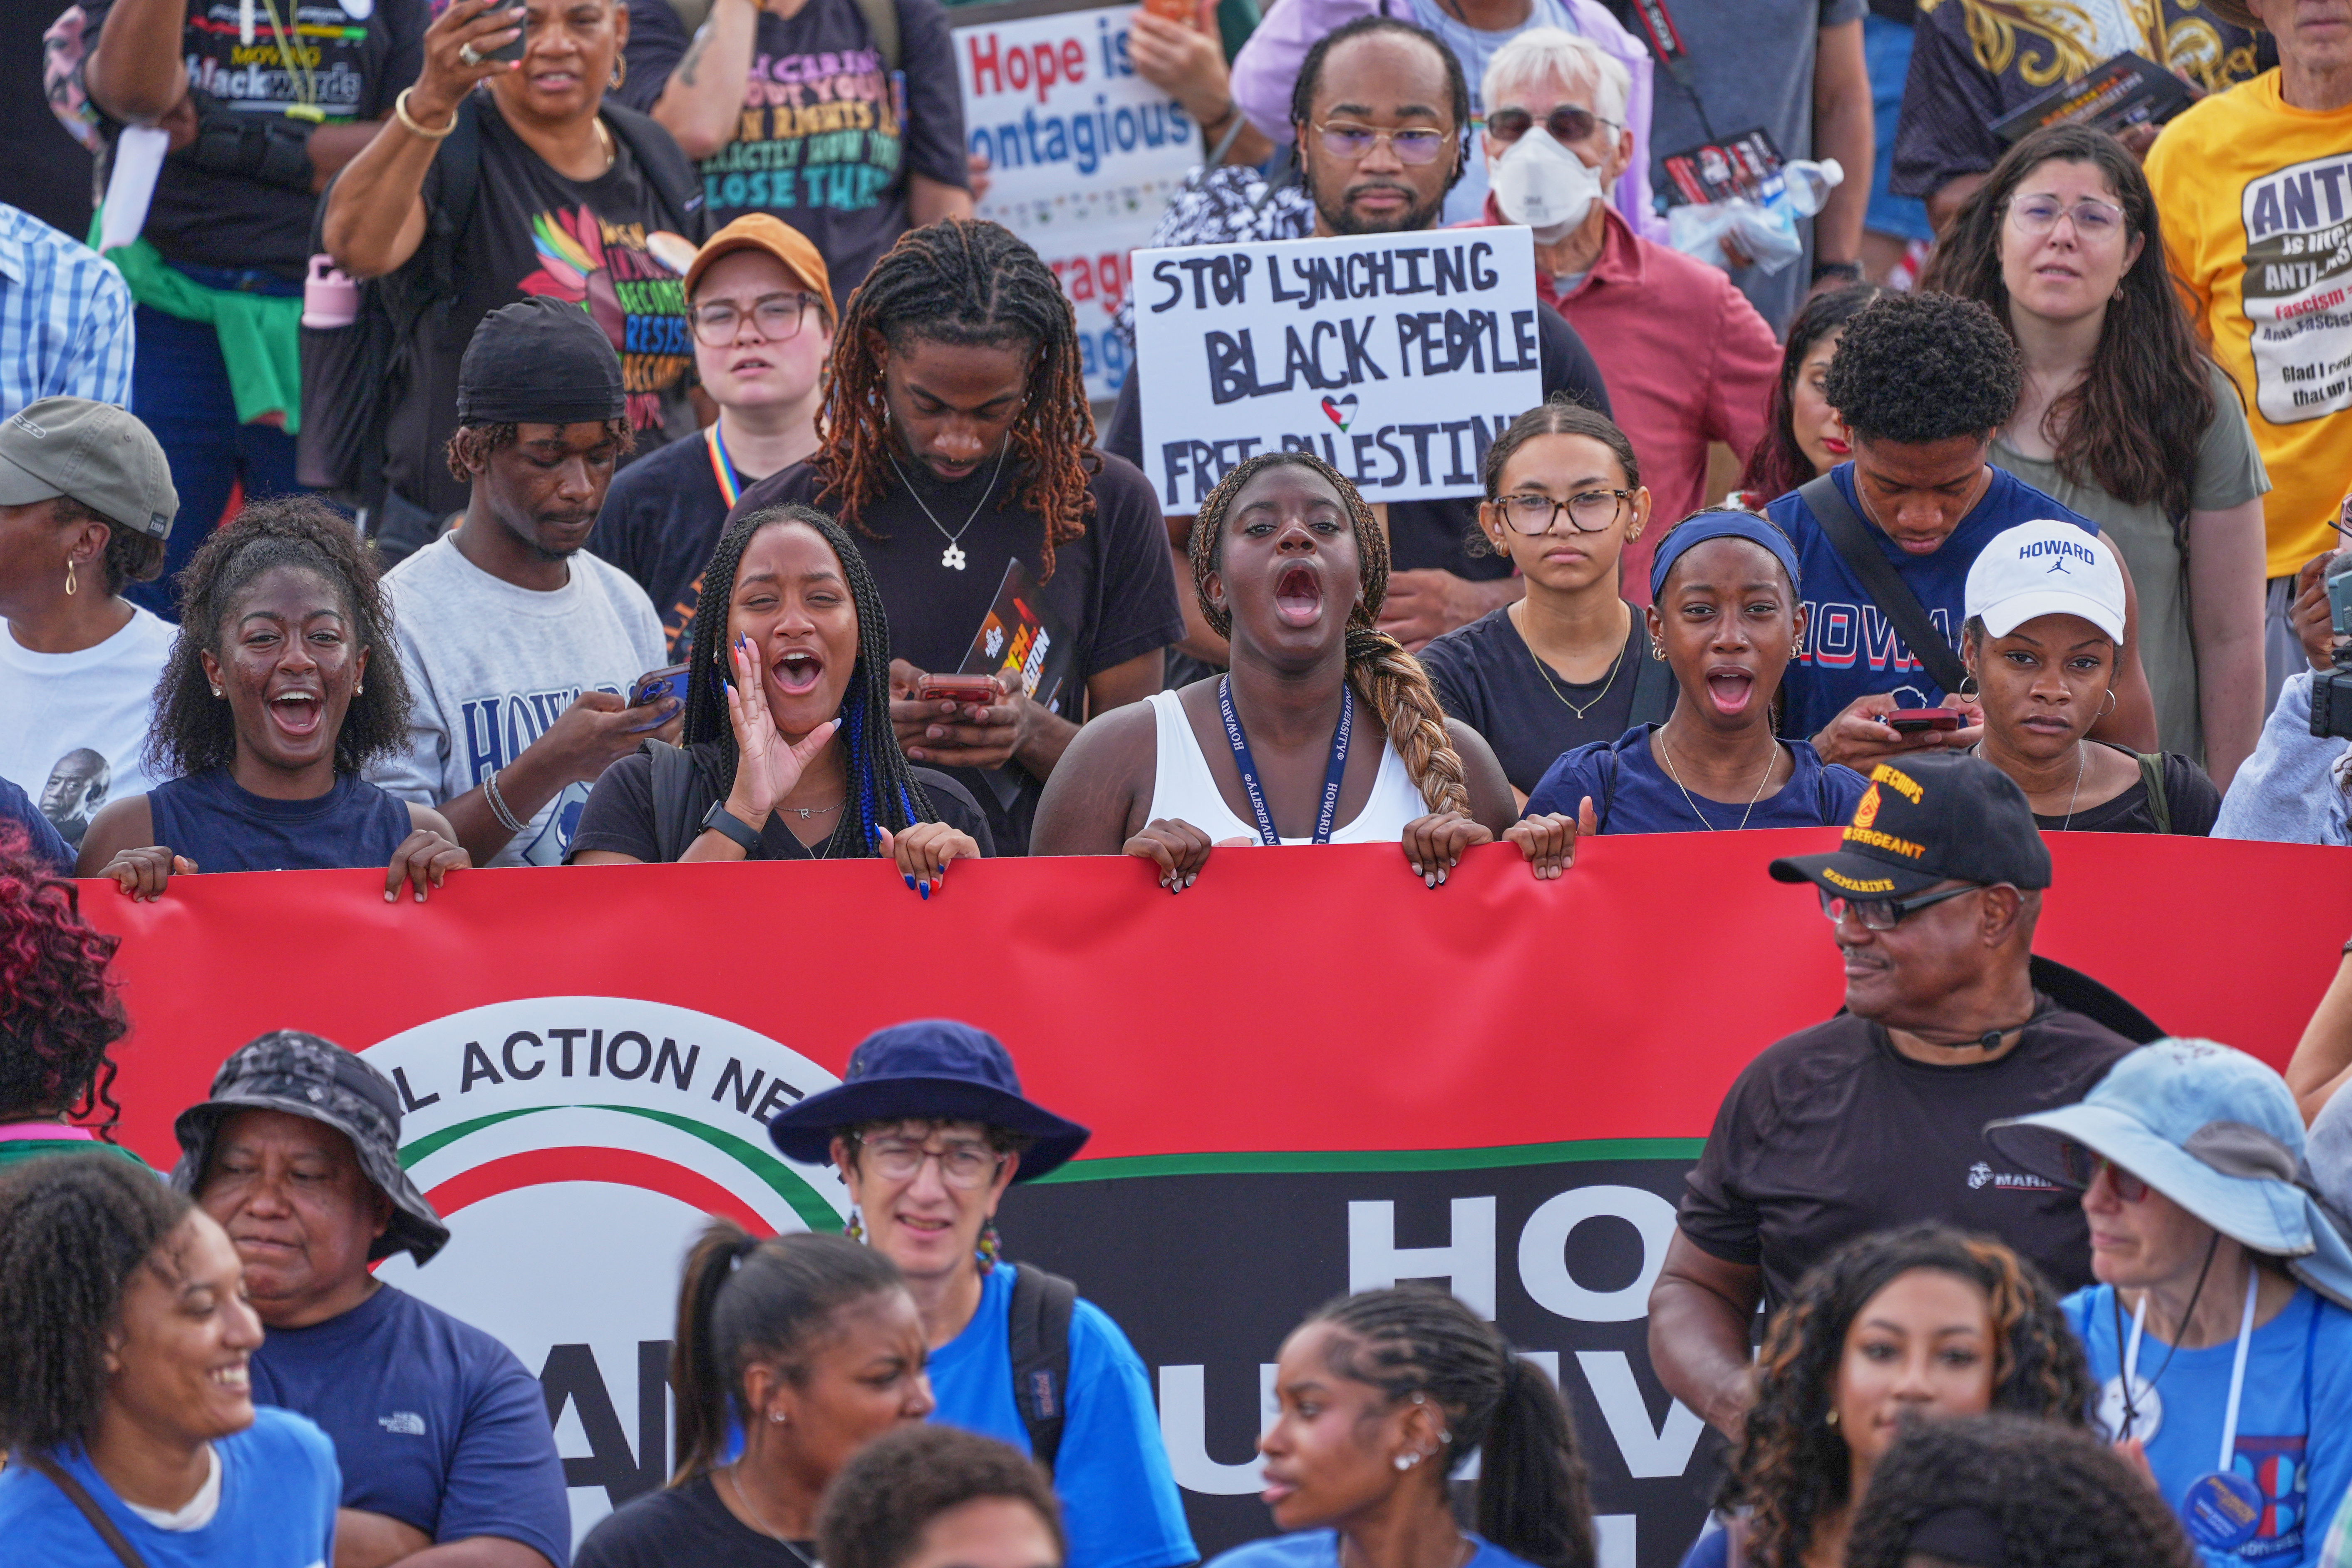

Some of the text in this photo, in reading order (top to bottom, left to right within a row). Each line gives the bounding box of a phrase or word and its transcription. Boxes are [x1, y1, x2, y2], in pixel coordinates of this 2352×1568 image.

[970, 17, 1135, 104] Hope is
[704, 169, 797, 211] LOSE
[1152, 243, 1499, 313] STOP LYNCHING
[1205, 308, 1539, 404] BLACK PEOPLE
[2283, 363, 2316, 384] Glad
[2320, 361, 2325, 378] I
[2293, 389, 2326, 407] that
[2327, 380, 2345, 398] up
[2020, 540, 2094, 565] HOWARD
[1221, 700, 1244, 751] HOWARD
[1888, 769, 1924, 804] CORPS
[1318, 783, 1338, 836] HOWARD
[1851, 827, 1926, 859] SERGEANT
[1841, 878, 1895, 892] MARINE
[460, 1028, 700, 1094] ACTION
